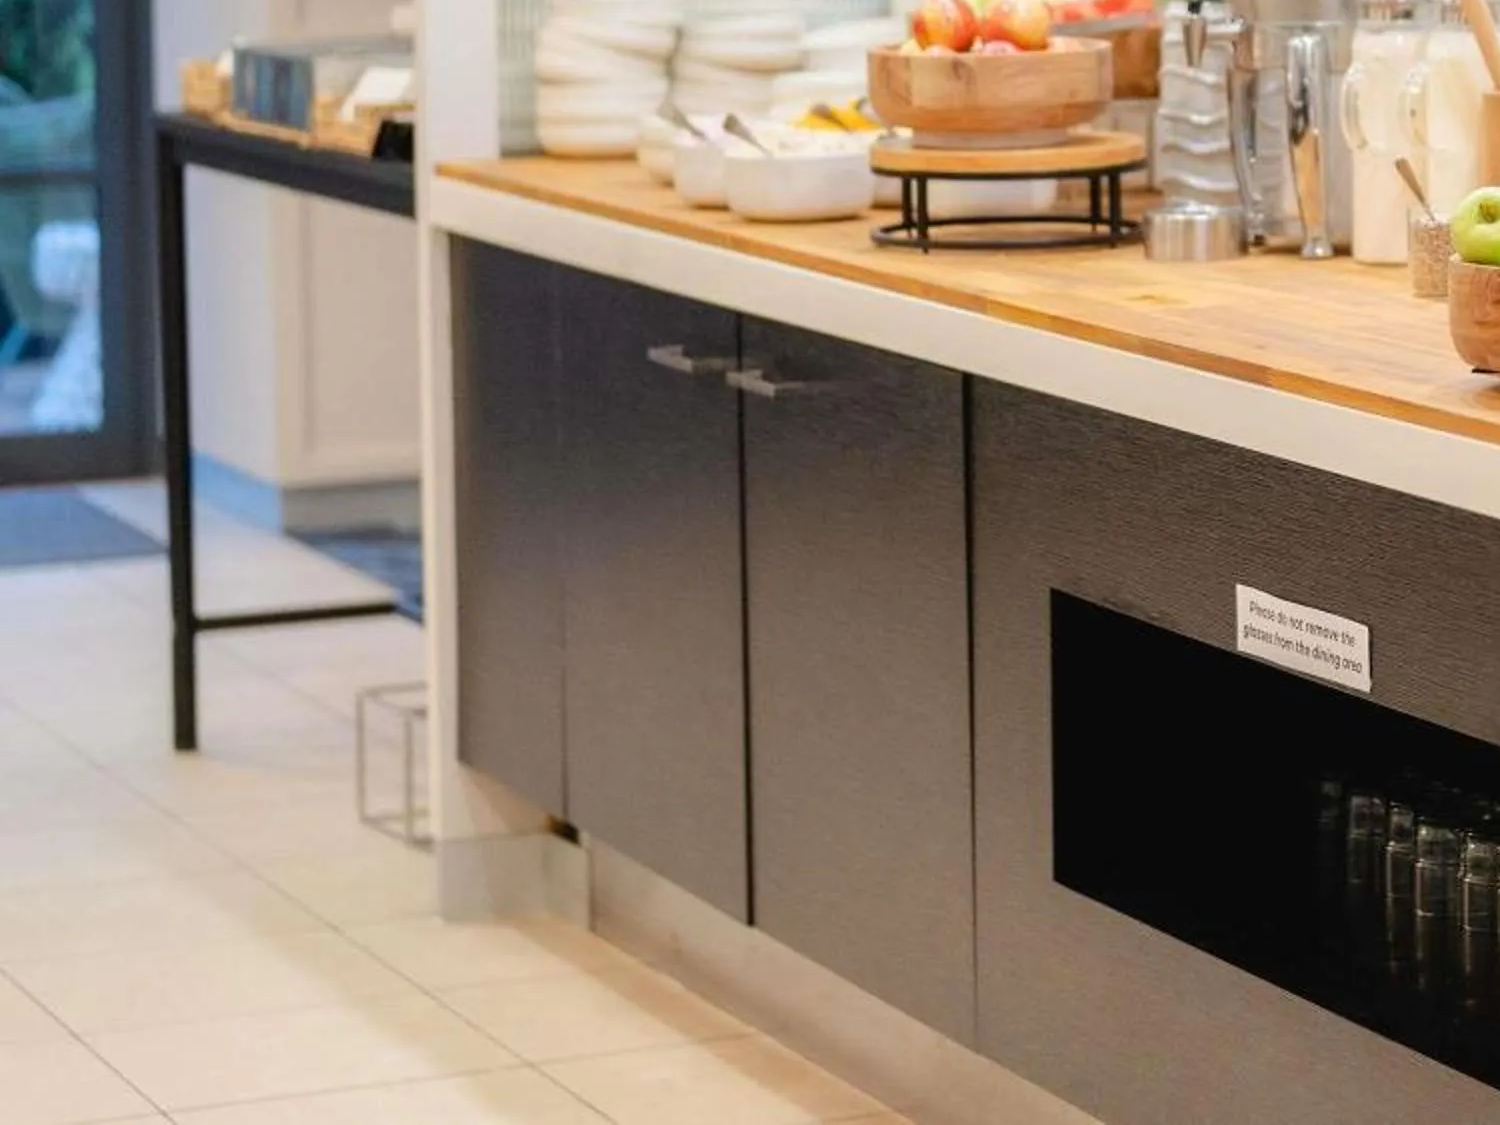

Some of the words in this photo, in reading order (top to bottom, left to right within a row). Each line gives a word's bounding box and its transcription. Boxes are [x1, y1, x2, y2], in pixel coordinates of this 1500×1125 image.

[1249, 600, 1275, 622] Please
[1289, 615, 1304, 632] not
[1305, 621, 1338, 642] remove
[1341, 630, 1356, 648] the
[1272, 629, 1295, 651] from
[1295, 638, 1310, 658] the
[1311, 645, 1341, 670] dining
[1342, 658, 1363, 674] area
